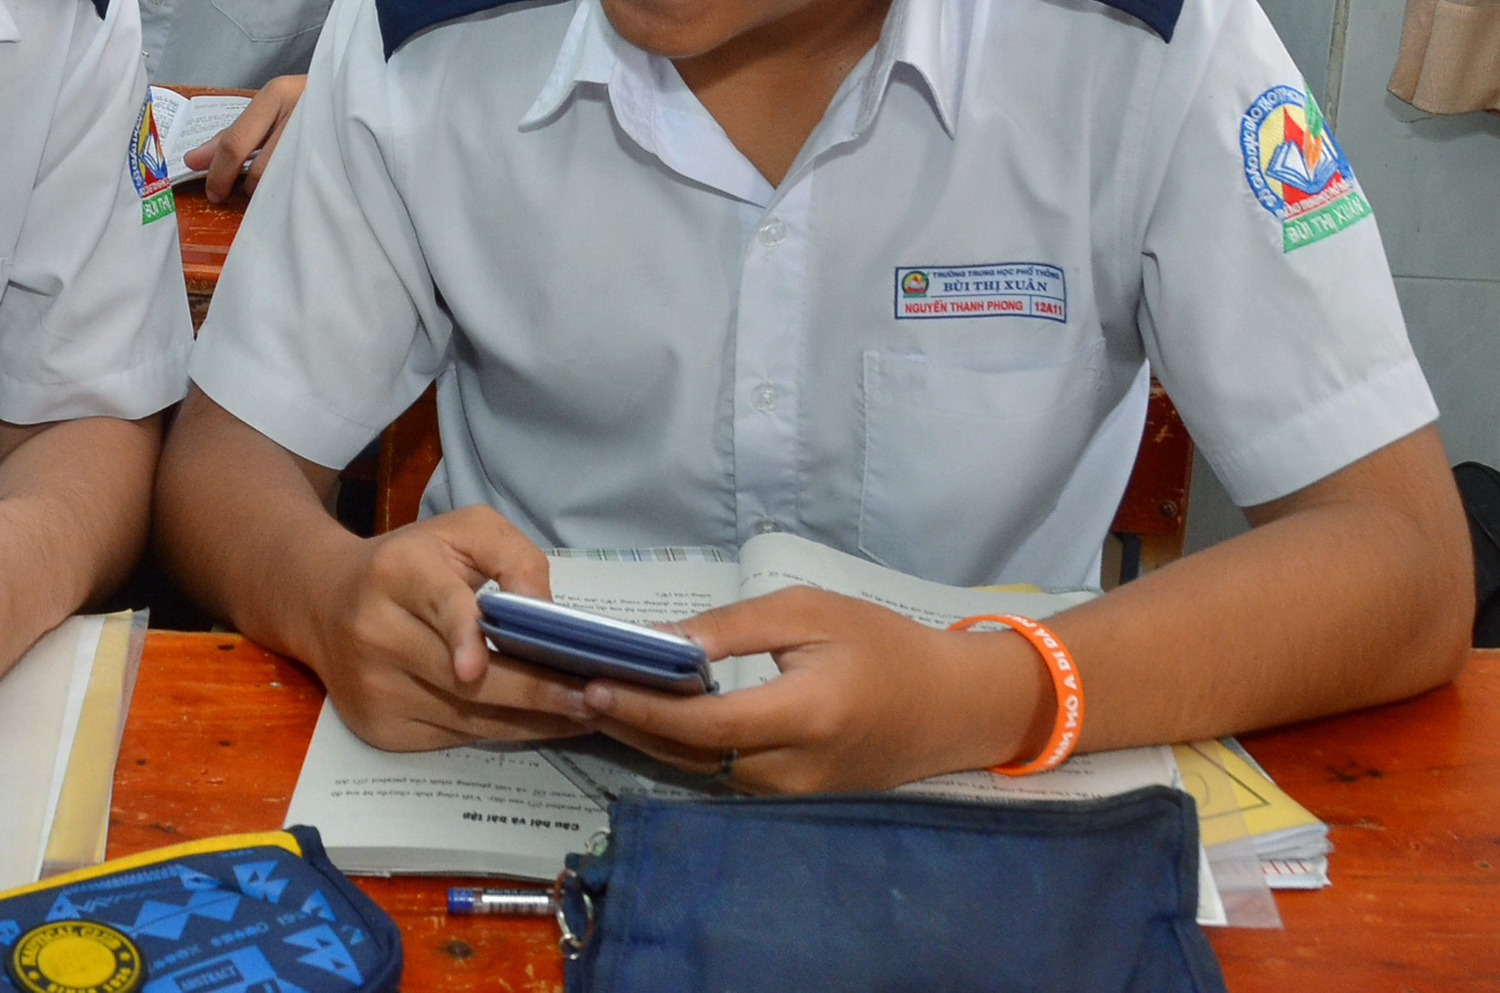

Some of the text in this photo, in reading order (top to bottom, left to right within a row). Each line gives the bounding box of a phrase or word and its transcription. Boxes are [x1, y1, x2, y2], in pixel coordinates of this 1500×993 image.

[967, 269, 995, 277] TRUNG
[996, 268, 1014, 277] HỌC
[943, 278, 1048, 293] BÙI THỊ XUÂN
[904, 299, 1063, 315] NGUYỄN THANH PHONG 12A11
[1063, 674, 1077, 690] A
[554, 821, 580, 832] Câu
